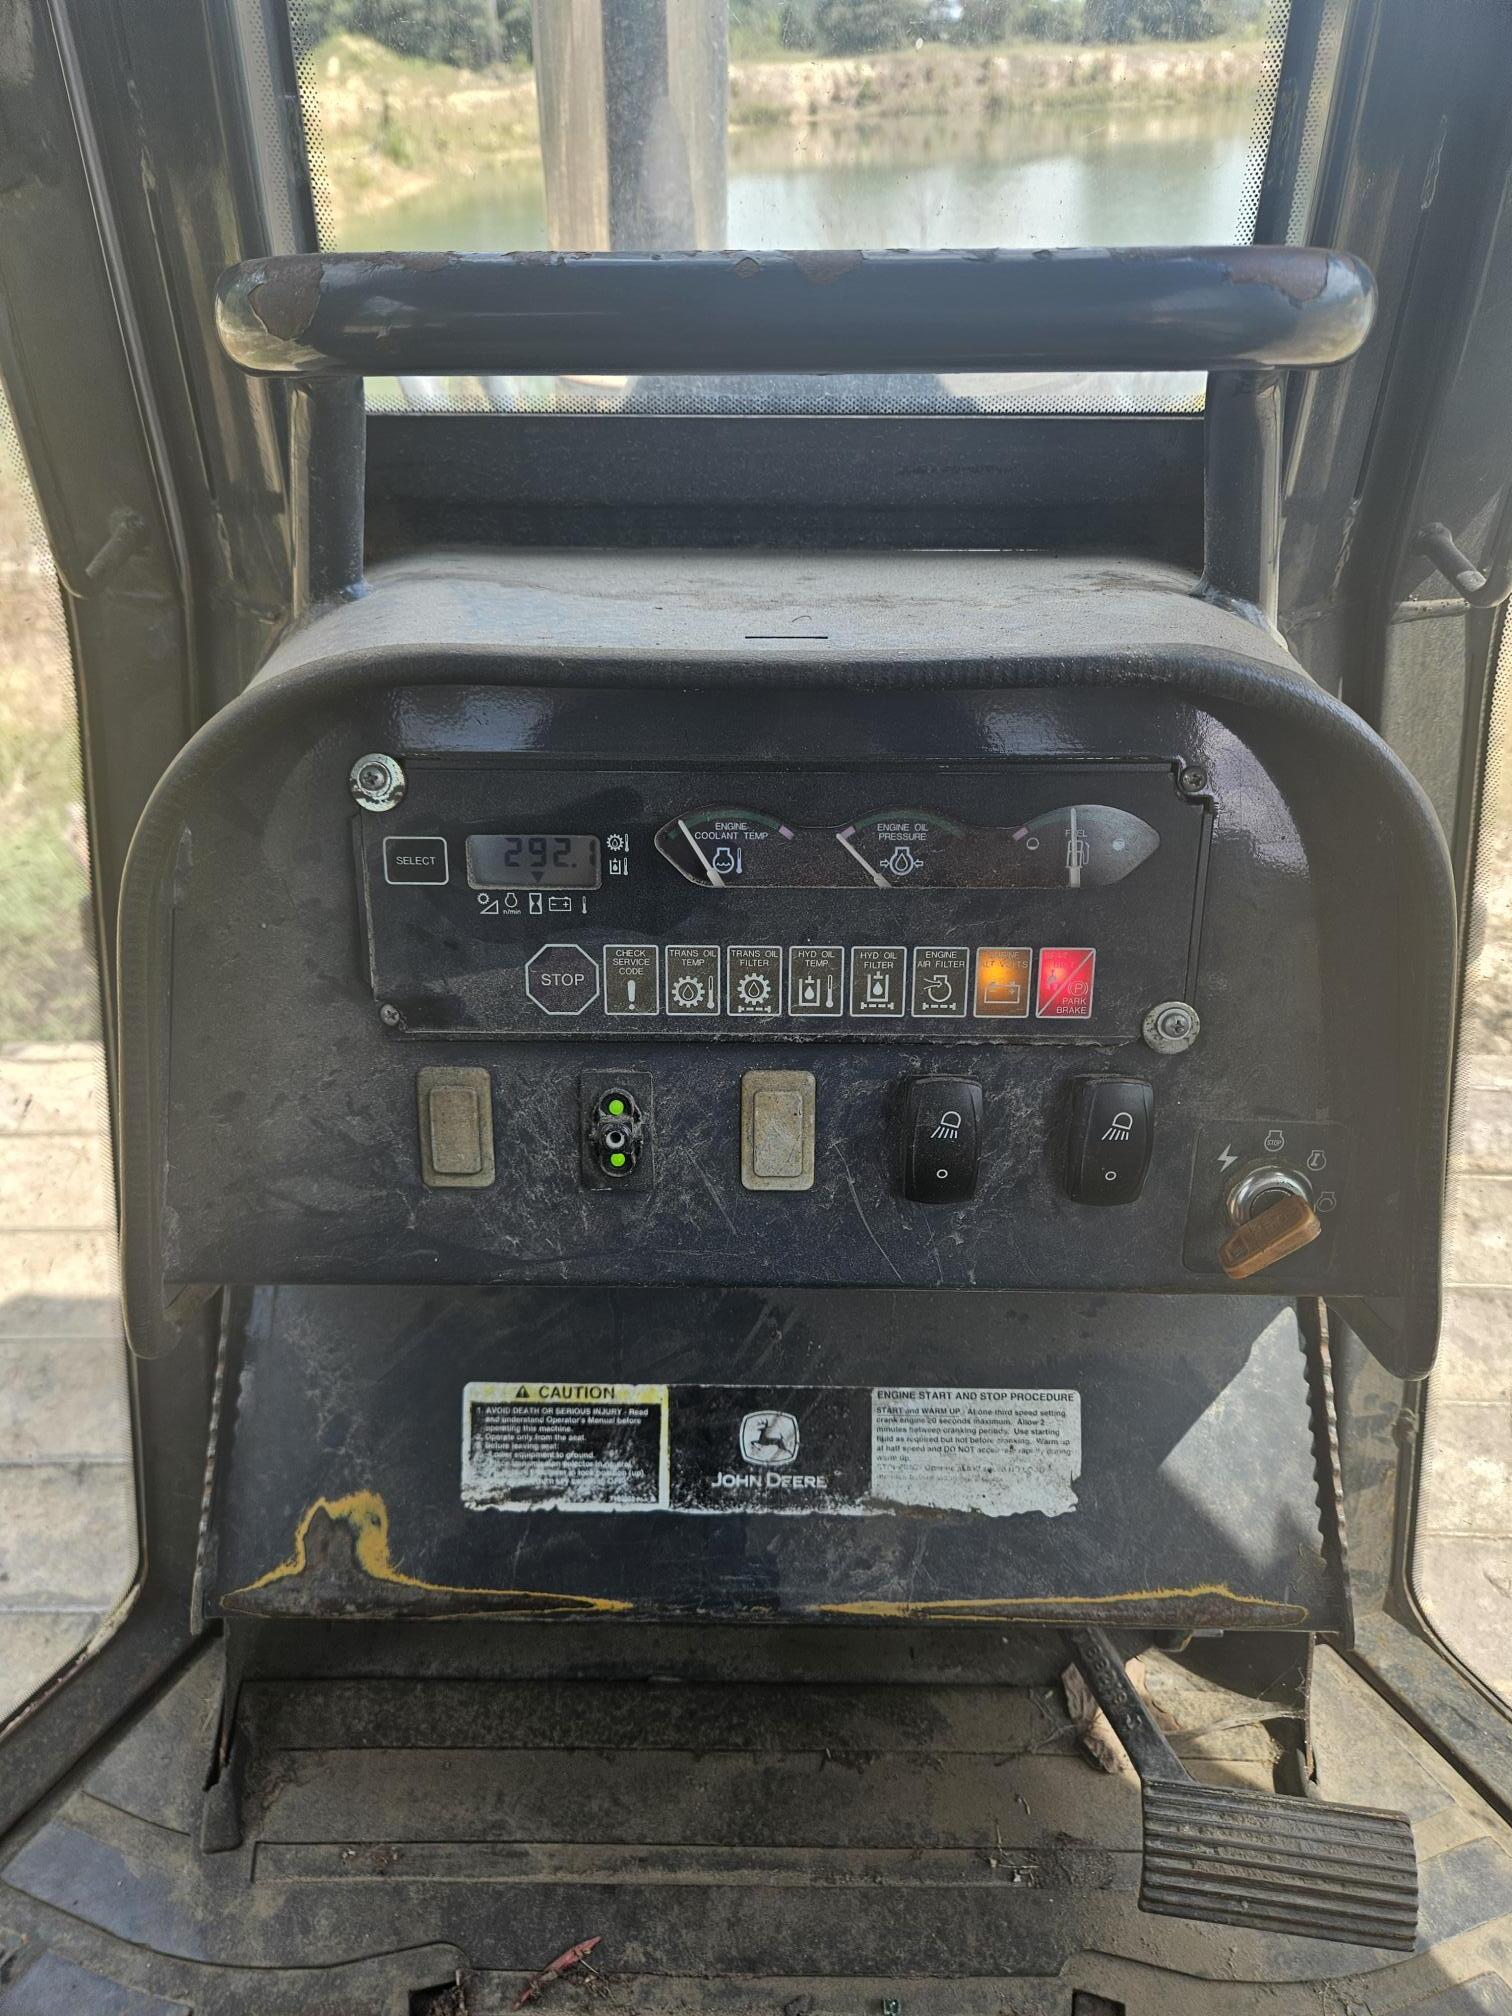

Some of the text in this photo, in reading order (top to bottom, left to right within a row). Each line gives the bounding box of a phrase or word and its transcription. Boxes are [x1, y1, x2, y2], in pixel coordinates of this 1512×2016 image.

[715, 822, 748, 831] ENGINE
[877, 824, 928, 832] ENGINE OIL
[694, 832, 769, 840] COOLANT TEMP
[878, 832, 927, 841] PRESSURE
[1065, 829, 1088, 838] FEL
[396, 856, 436, 866] SELECT
[615, 949, 646, 958] CHECK
[669, 950, 717, 958] TRANS OIL
[730, 950, 760, 958] TRANS
[860, 952, 898, 960] HYD OIL
[925, 951, 958, 959] ENGINE
[612, 958, 650, 966] SERVICE
[682, 958, 705, 966] TEMP
[864, 961, 894, 969] FILTER
[917, 960, 965, 968] AIR FILTER
[619, 967, 644, 975] CODE
[541, 973, 585, 987] STOP
[1062, 996, 1087, 1005] PARK
[1056, 1006, 1088, 1014] BRAKE
[538, 1384, 615, 1399] CAUTION
[877, 1390, 1074, 1402] ENGINE START AND STOP PROCEDURE
[486, 1406, 510, 1414] AVOID
[512, 1406, 540, 1414] DEATH
[542, 1406, 554, 1414] OR
[556, 1407, 591, 1416] SERIOUS
[593, 1408, 622, 1416] INJURY
[628, 1408, 648, 1416] Read
[876, 1406, 902, 1415] START
[905, 1407, 920, 1415] and
[994, 1408, 1013, 1416] third
[1014, 1410, 1038, 1418] speed
[1040, 1410, 1066, 1419] setting
[502, 1416, 545, 1424] understand
[546, 1416, 586, 1426] Operator's
[587, 1416, 616, 1424] Manual
[616, 1416, 642, 1426] before
[938, 1416, 972, 1425] seconds
[485, 1424, 521, 1434] operating
[942, 1427, 978, 1436] cranking
[1030, 1428, 1060, 1438] starting
[485, 1433, 516, 1442] Operate
[516, 1434, 533, 1442] only
[958, 1446, 976, 1454] NOT
[712, 1472, 828, 1489] JOHN DEERE
